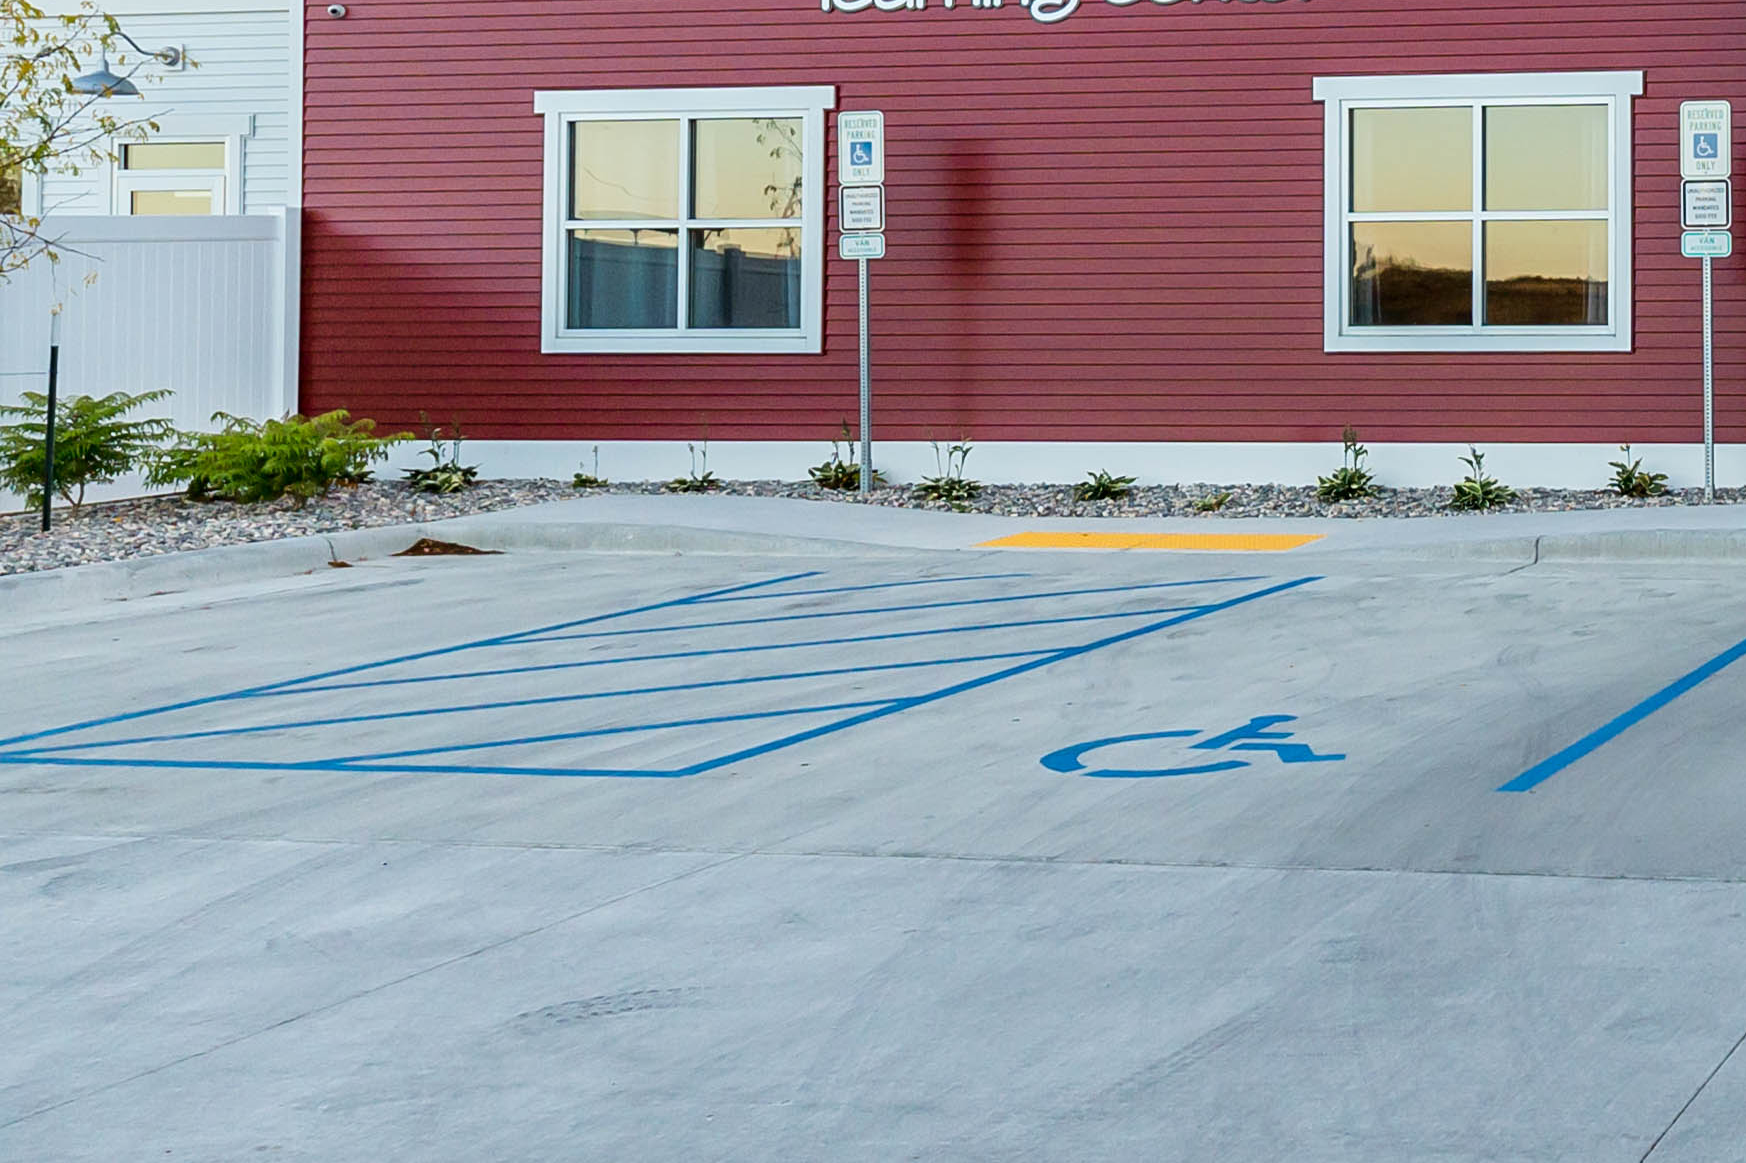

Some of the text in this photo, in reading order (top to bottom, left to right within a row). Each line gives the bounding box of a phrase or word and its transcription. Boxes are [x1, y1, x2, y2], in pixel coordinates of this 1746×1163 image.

[1687, 109, 1724, 120] RESERVED
[844, 119, 878, 129] RESERVED
[1689, 121, 1722, 131] PARKING
[1696, 160, 1715, 171] ONLY
